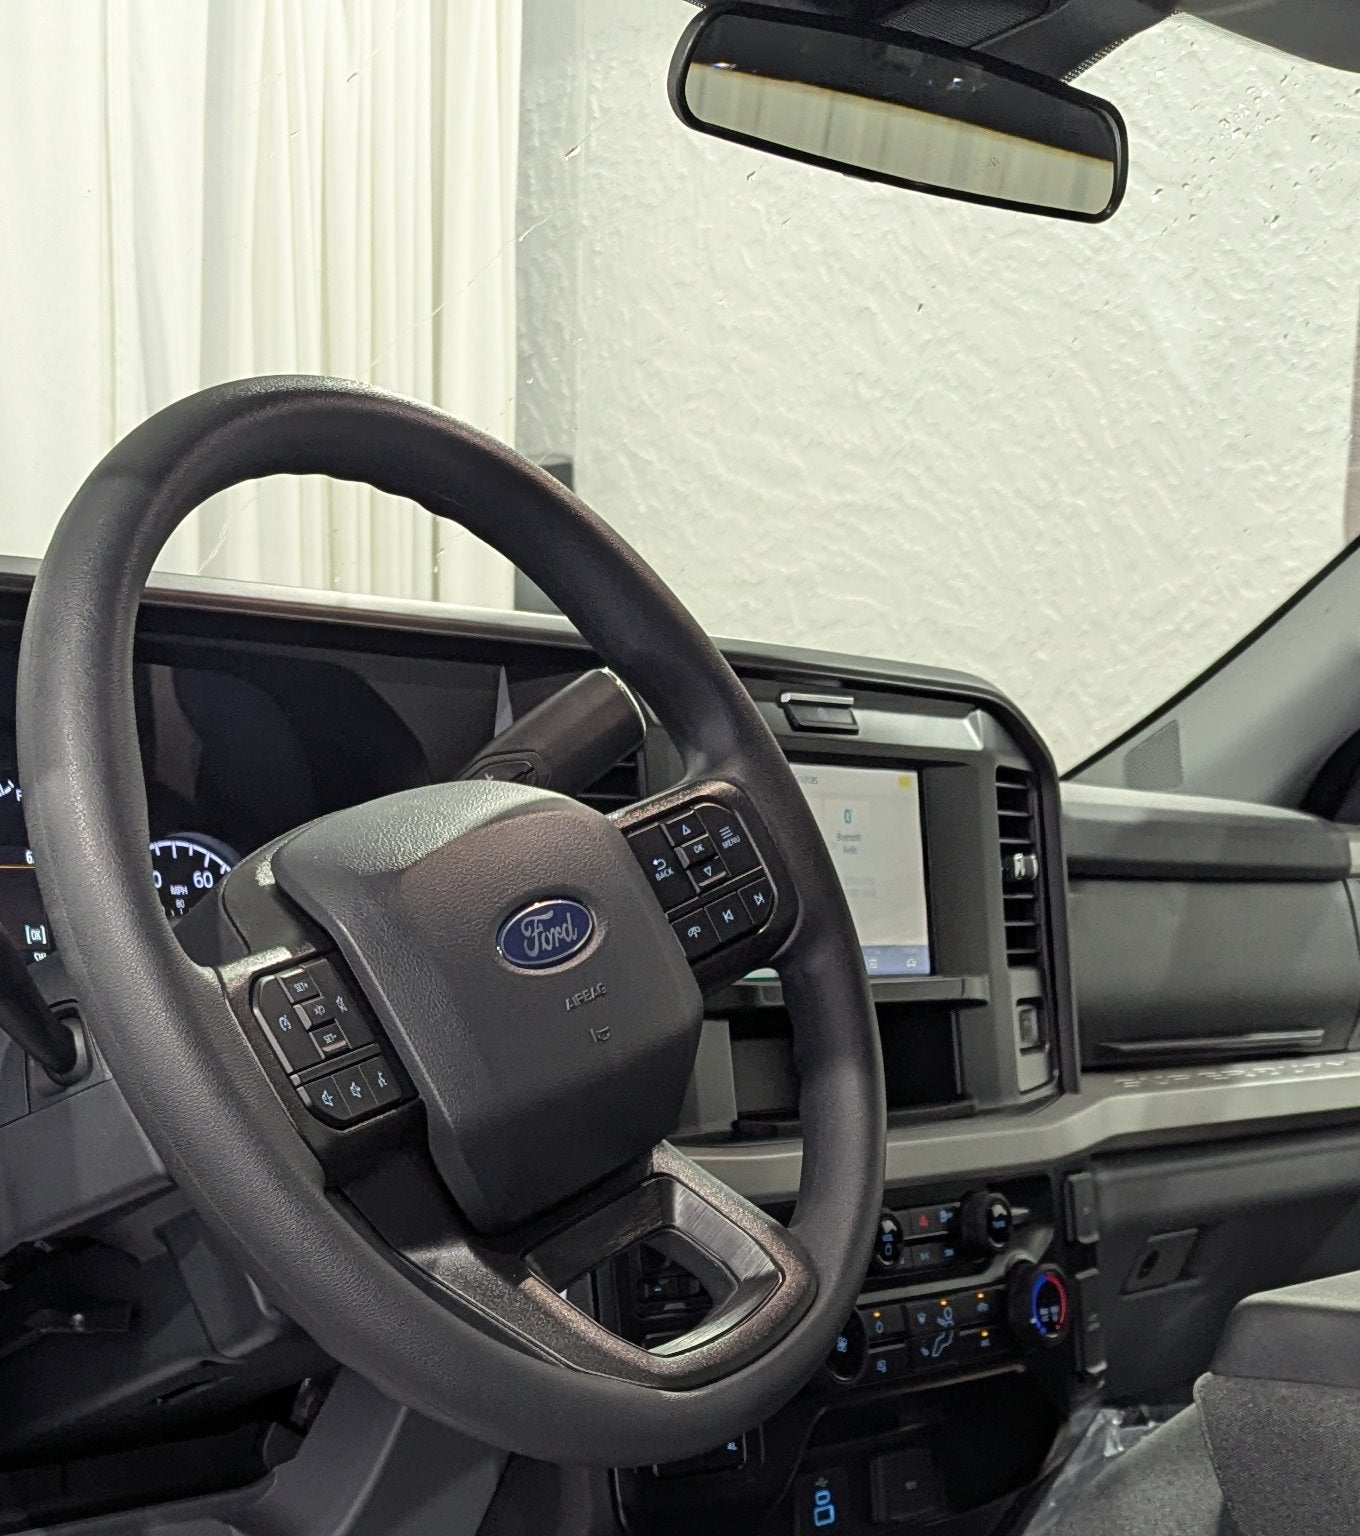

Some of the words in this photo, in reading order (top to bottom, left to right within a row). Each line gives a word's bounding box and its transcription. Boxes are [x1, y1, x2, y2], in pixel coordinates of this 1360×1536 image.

[693, 844, 705, 854] OK
[721, 835, 741, 849] MENU
[192, 870, 215, 889] 60
[654, 867, 674, 882] BACK
[520, 909, 578, 958] Ford
